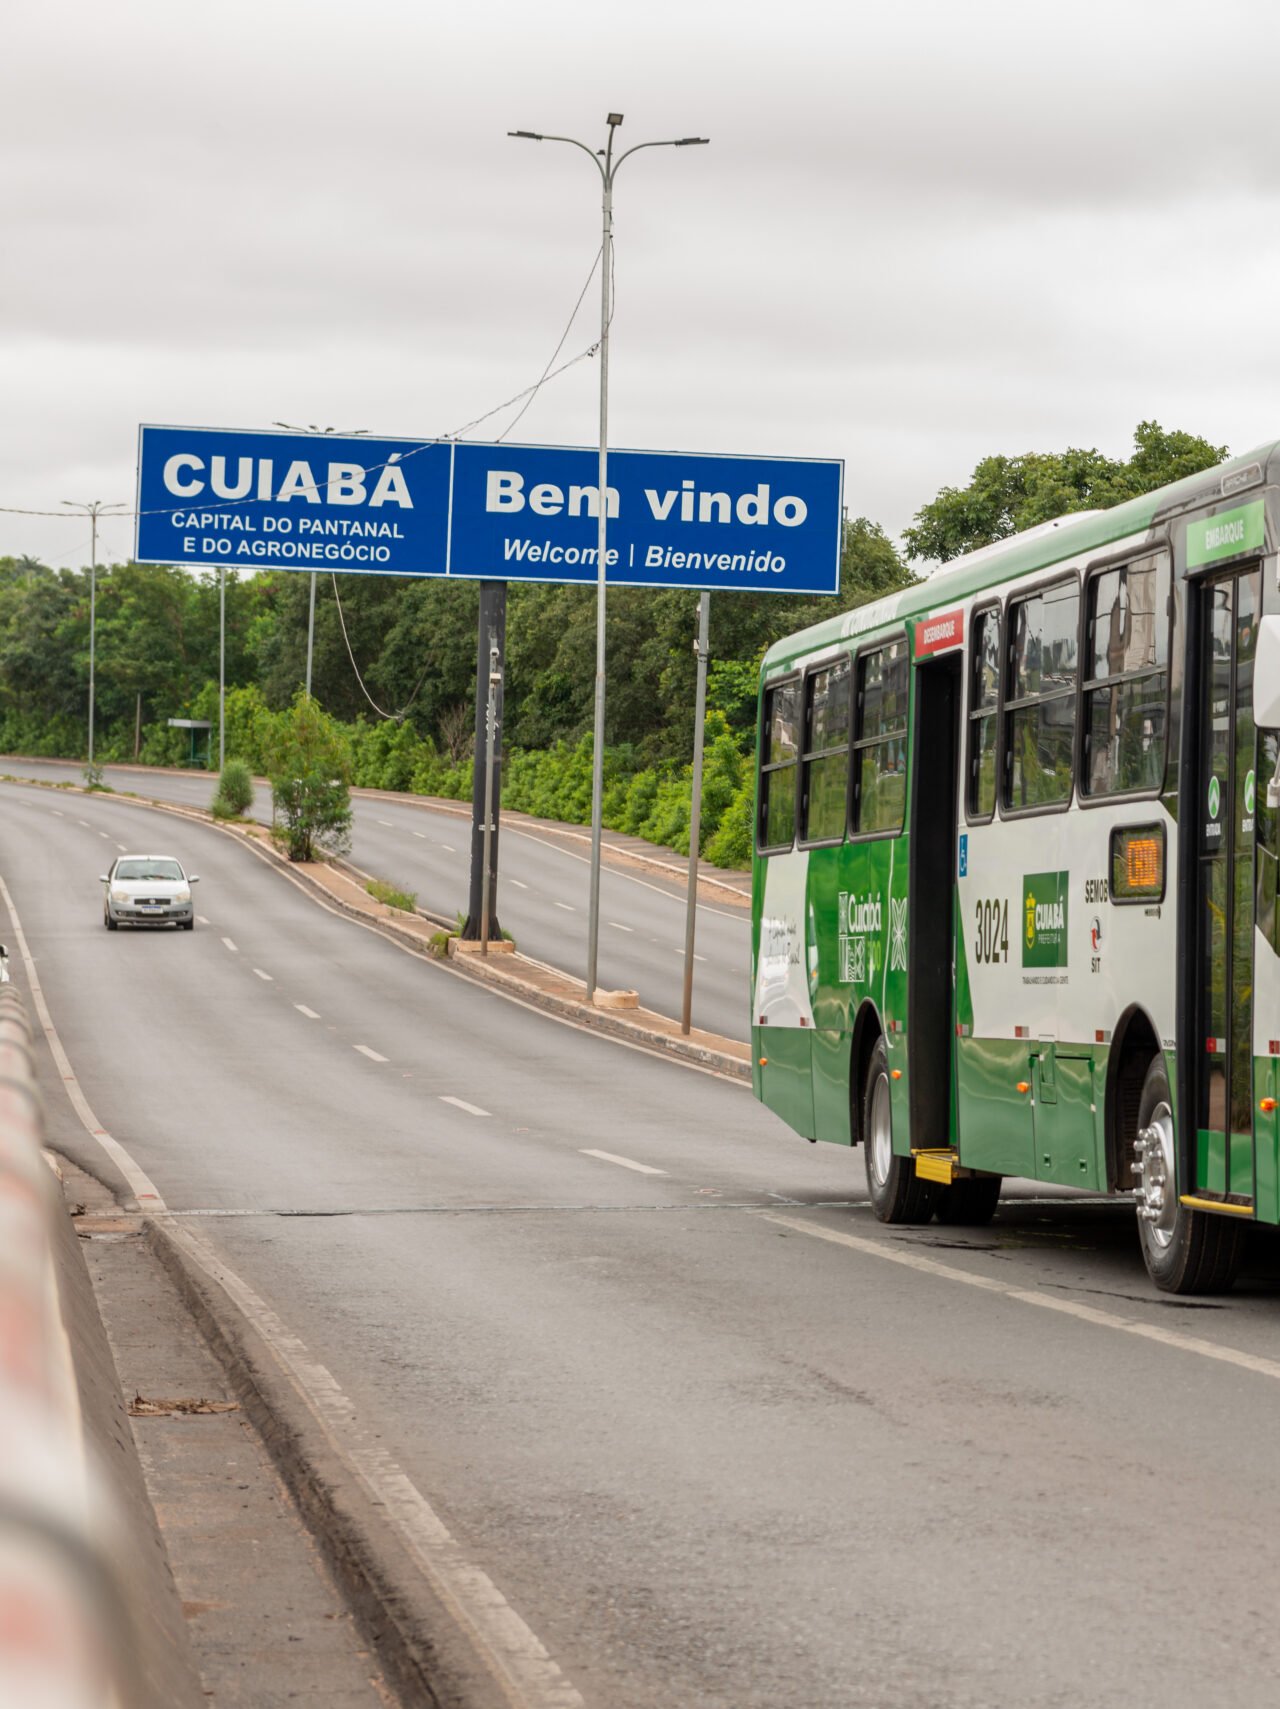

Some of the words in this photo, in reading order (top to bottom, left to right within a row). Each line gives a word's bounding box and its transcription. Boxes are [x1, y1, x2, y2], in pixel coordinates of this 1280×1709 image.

[163, 453, 414, 509] CUIABÁ
[486, 470, 620, 519] Bem
[644, 480, 808, 527] vindo
[171, 512, 257, 532] CAPITAL
[263, 516, 292, 533] DO
[299, 518, 404, 539] PANTANAL
[1205, 519, 1245, 550] EMBARQUE
[183, 537, 196, 553] E
[202, 538, 232, 554] DO
[236, 539, 391, 562] AGRONEGÓCIO
[504, 538, 619, 566] Welcome
[644, 545, 786, 574] Bienvenido
[1085, 878, 1108, 903] SEMOB
[848, 891, 882, 933] Cuiabá
[1035, 895, 1065, 931] CUIABÁ
[975, 898, 1009, 964] 3024
